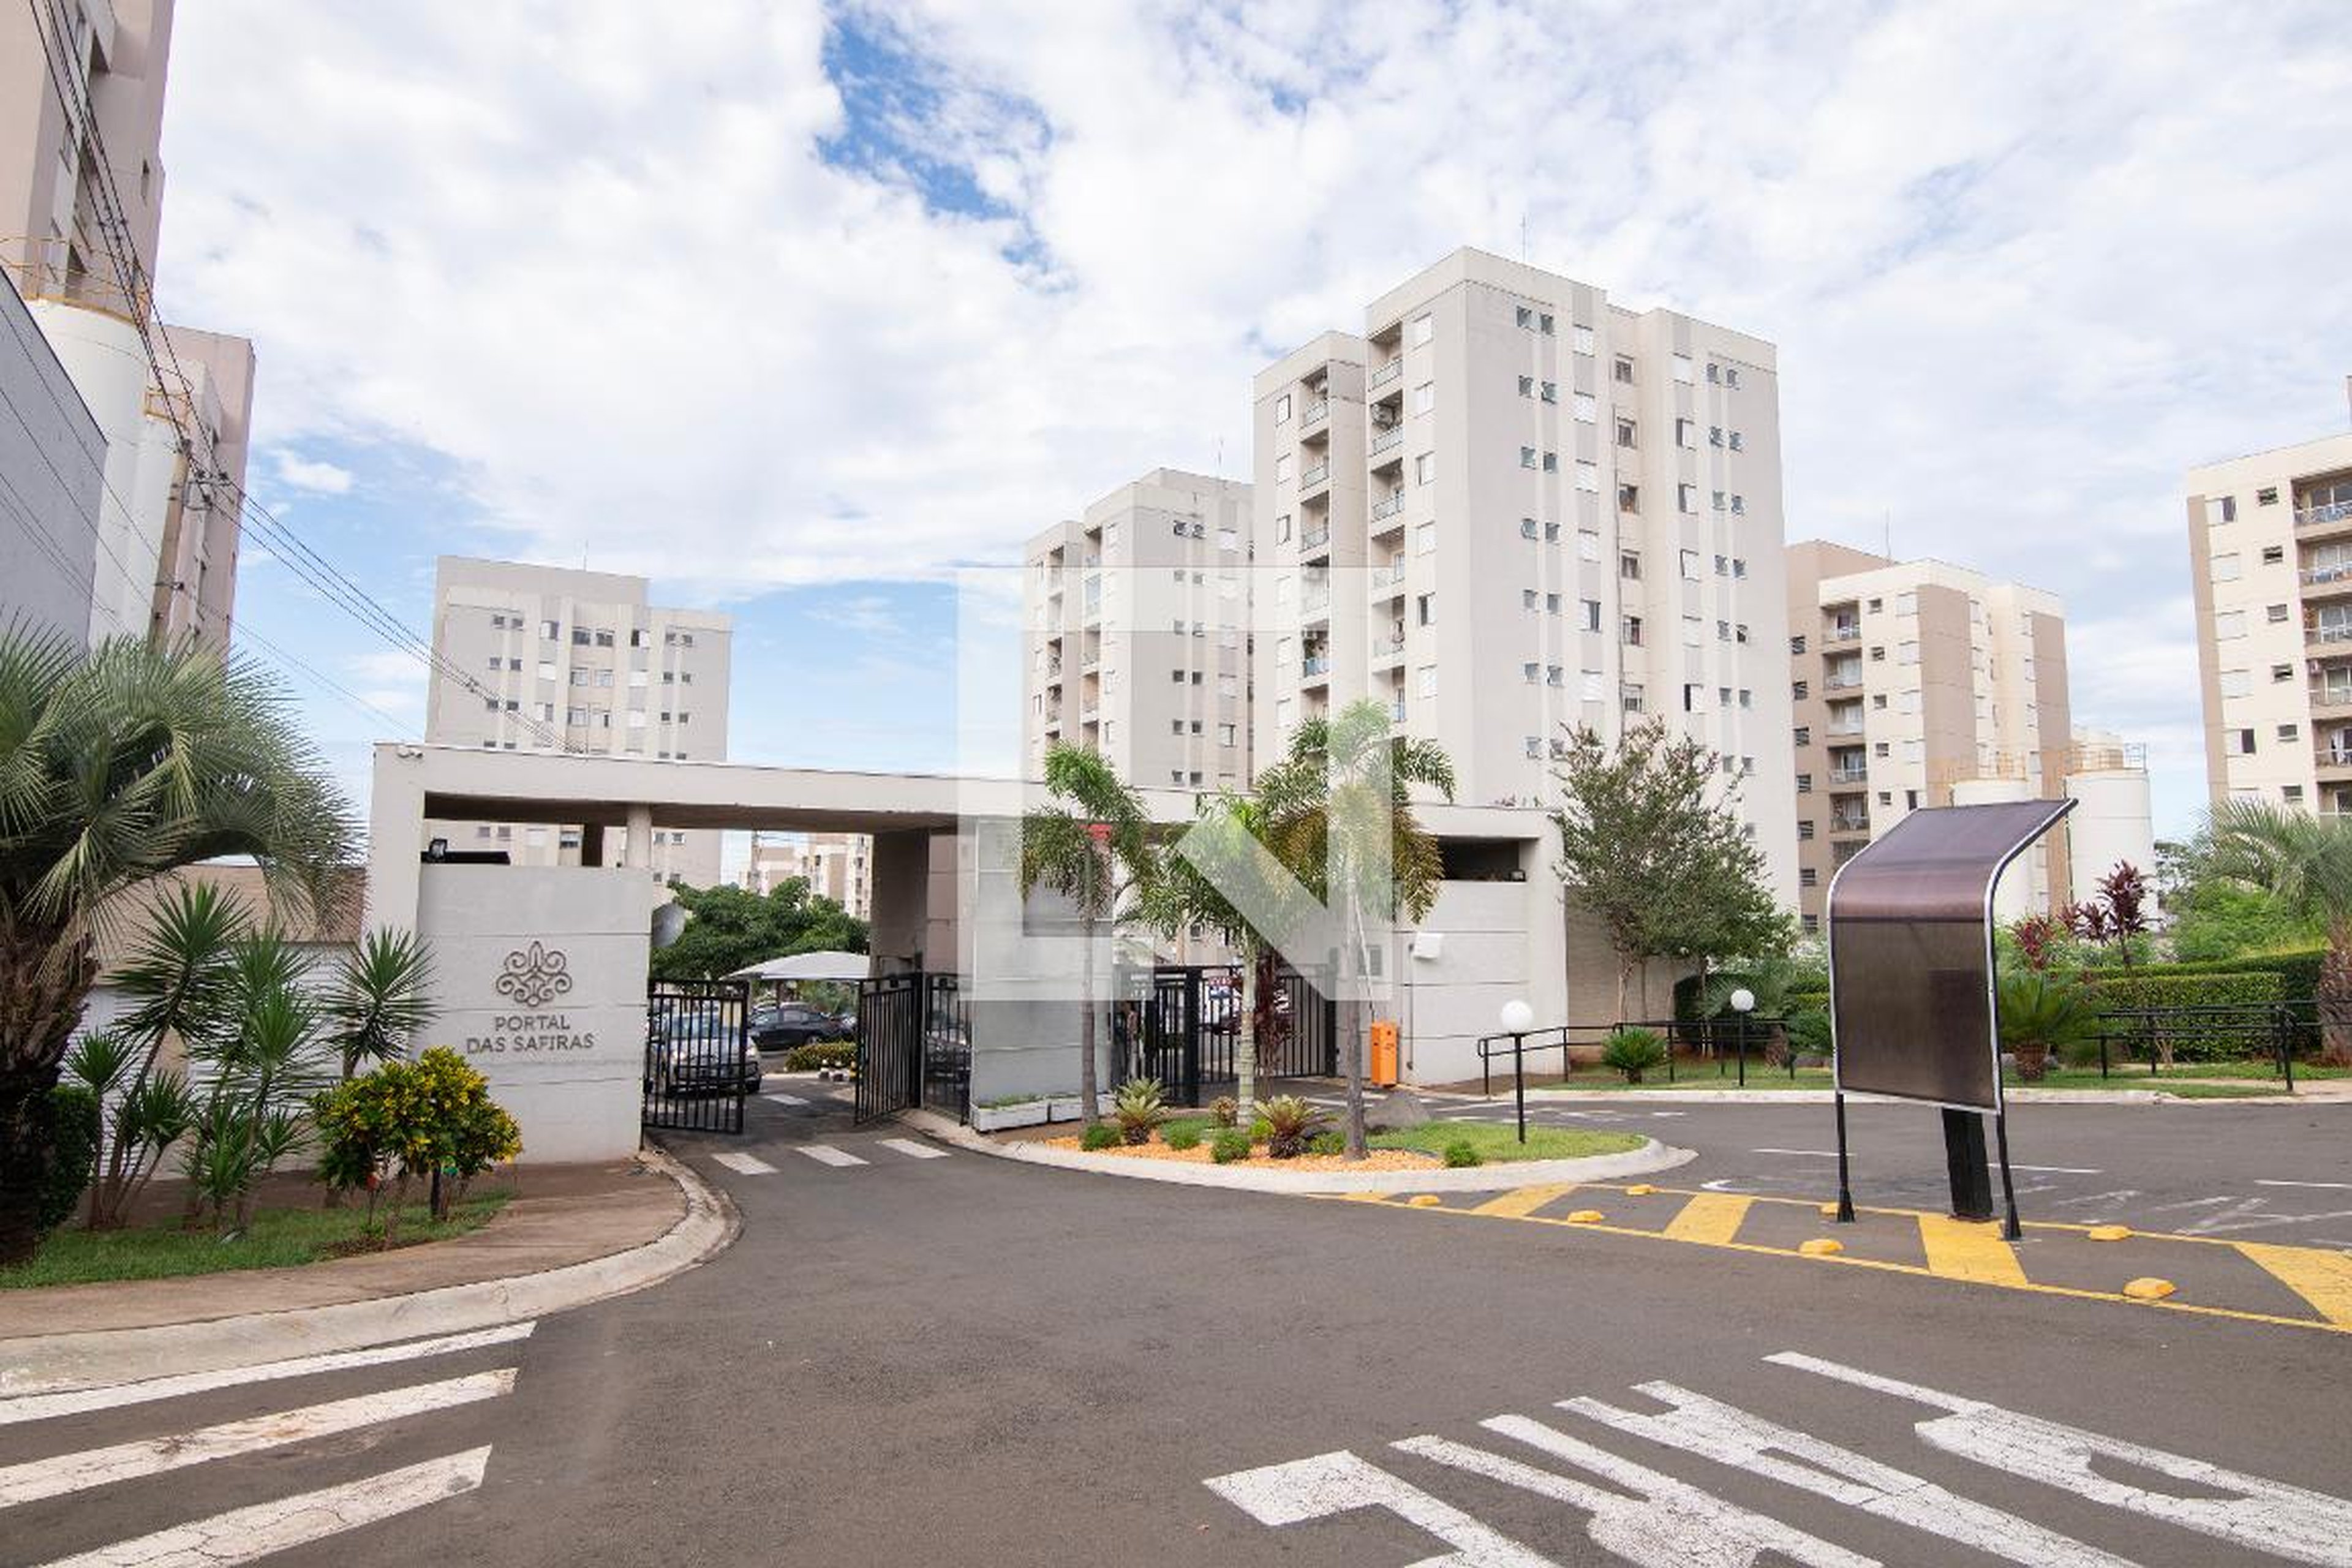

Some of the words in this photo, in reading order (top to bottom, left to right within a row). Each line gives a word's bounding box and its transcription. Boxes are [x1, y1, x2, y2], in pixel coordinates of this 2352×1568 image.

[495, 1014, 570, 1031] PORTAL
[467, 1037, 505, 1054] DAS
[513, 1033, 594, 1052] SAFIRAS
